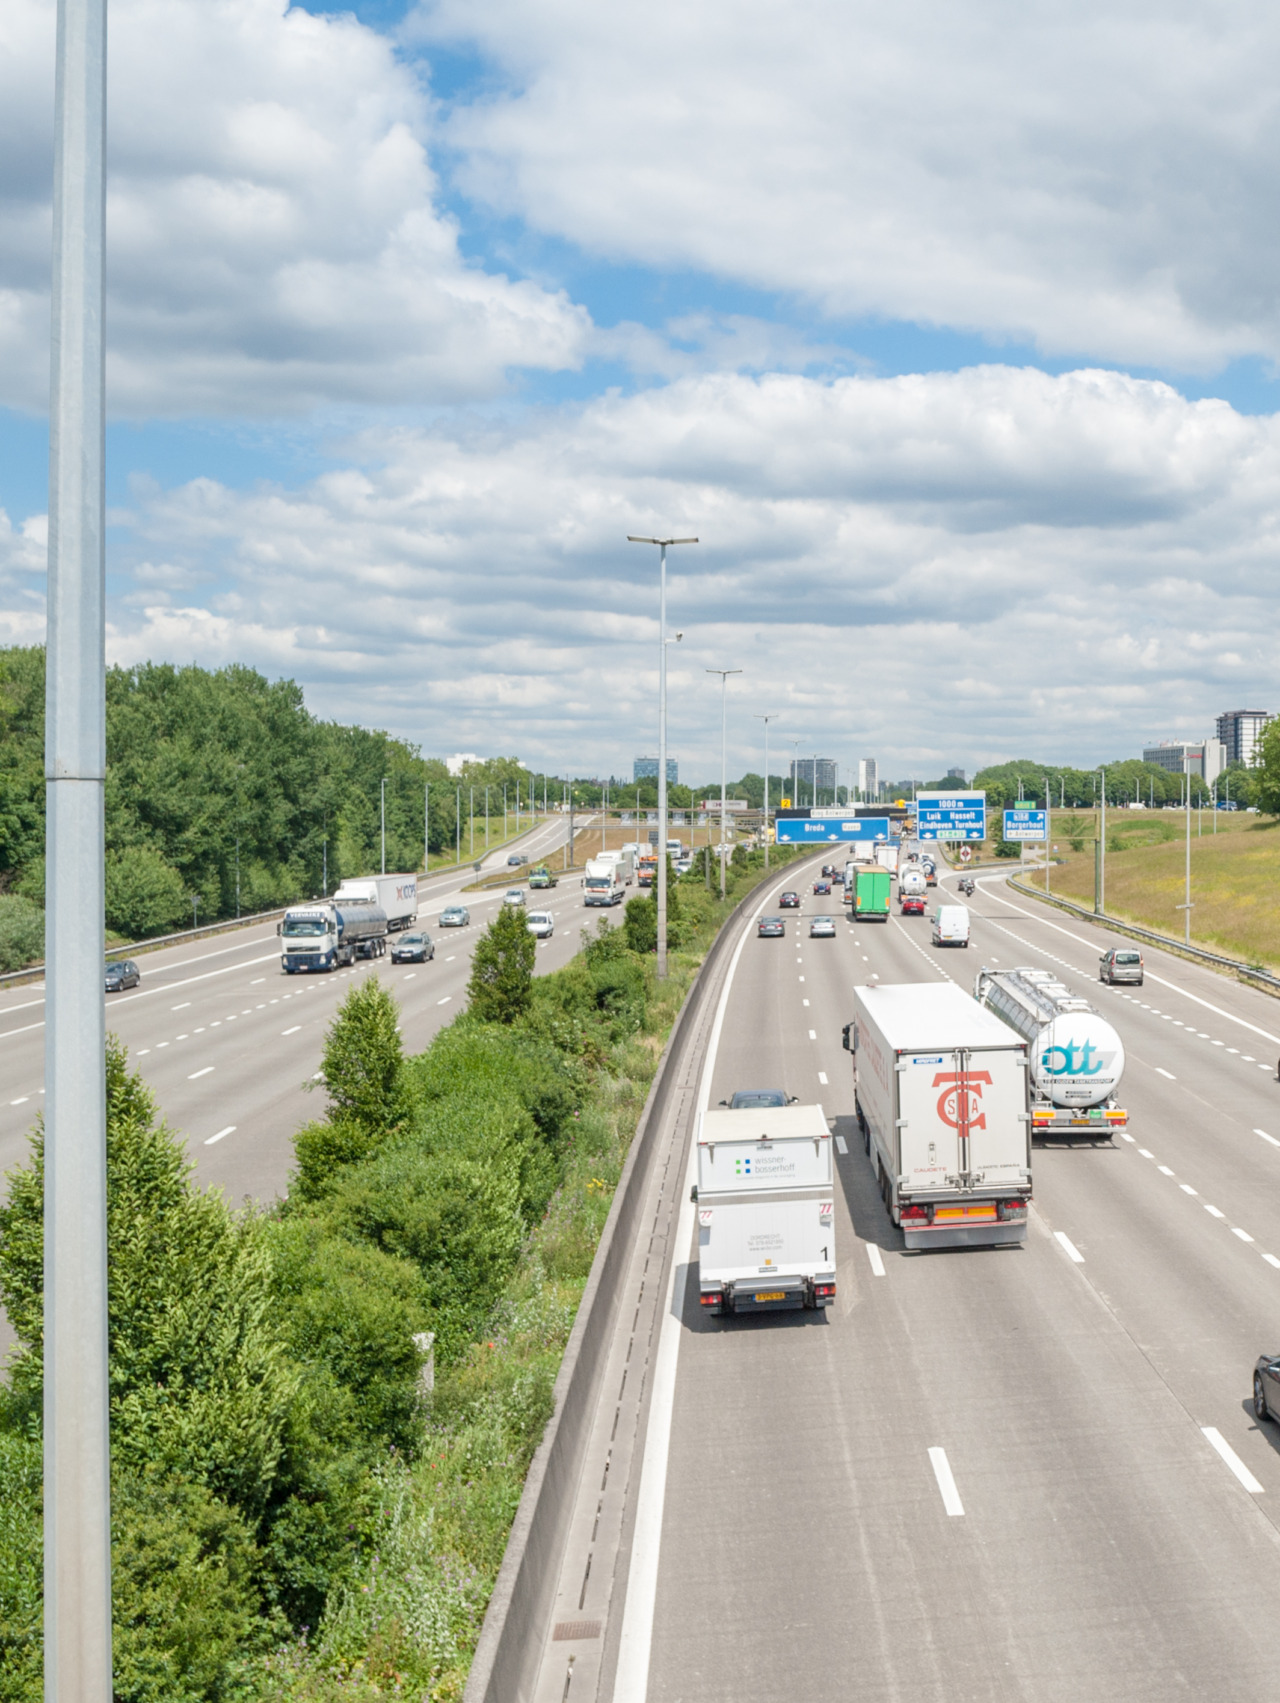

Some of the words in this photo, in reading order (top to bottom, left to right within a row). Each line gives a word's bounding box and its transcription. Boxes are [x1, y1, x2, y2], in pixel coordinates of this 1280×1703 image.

[938, 800, 956, 808] 1000
[825, 809, 854, 818] Antwerpen
[926, 812, 942, 820] Luik
[950, 811, 976, 820] Hasselt
[804, 823, 825, 832] Breda
[919, 821, 953, 829] Eindhoven
[955, 820, 983, 829] Turnhout
[1006, 820, 1044, 830] Borgerhout
[1015, 830, 1043, 838] Antwerpen
[754, 1163, 795, 1174] bosserhoff
